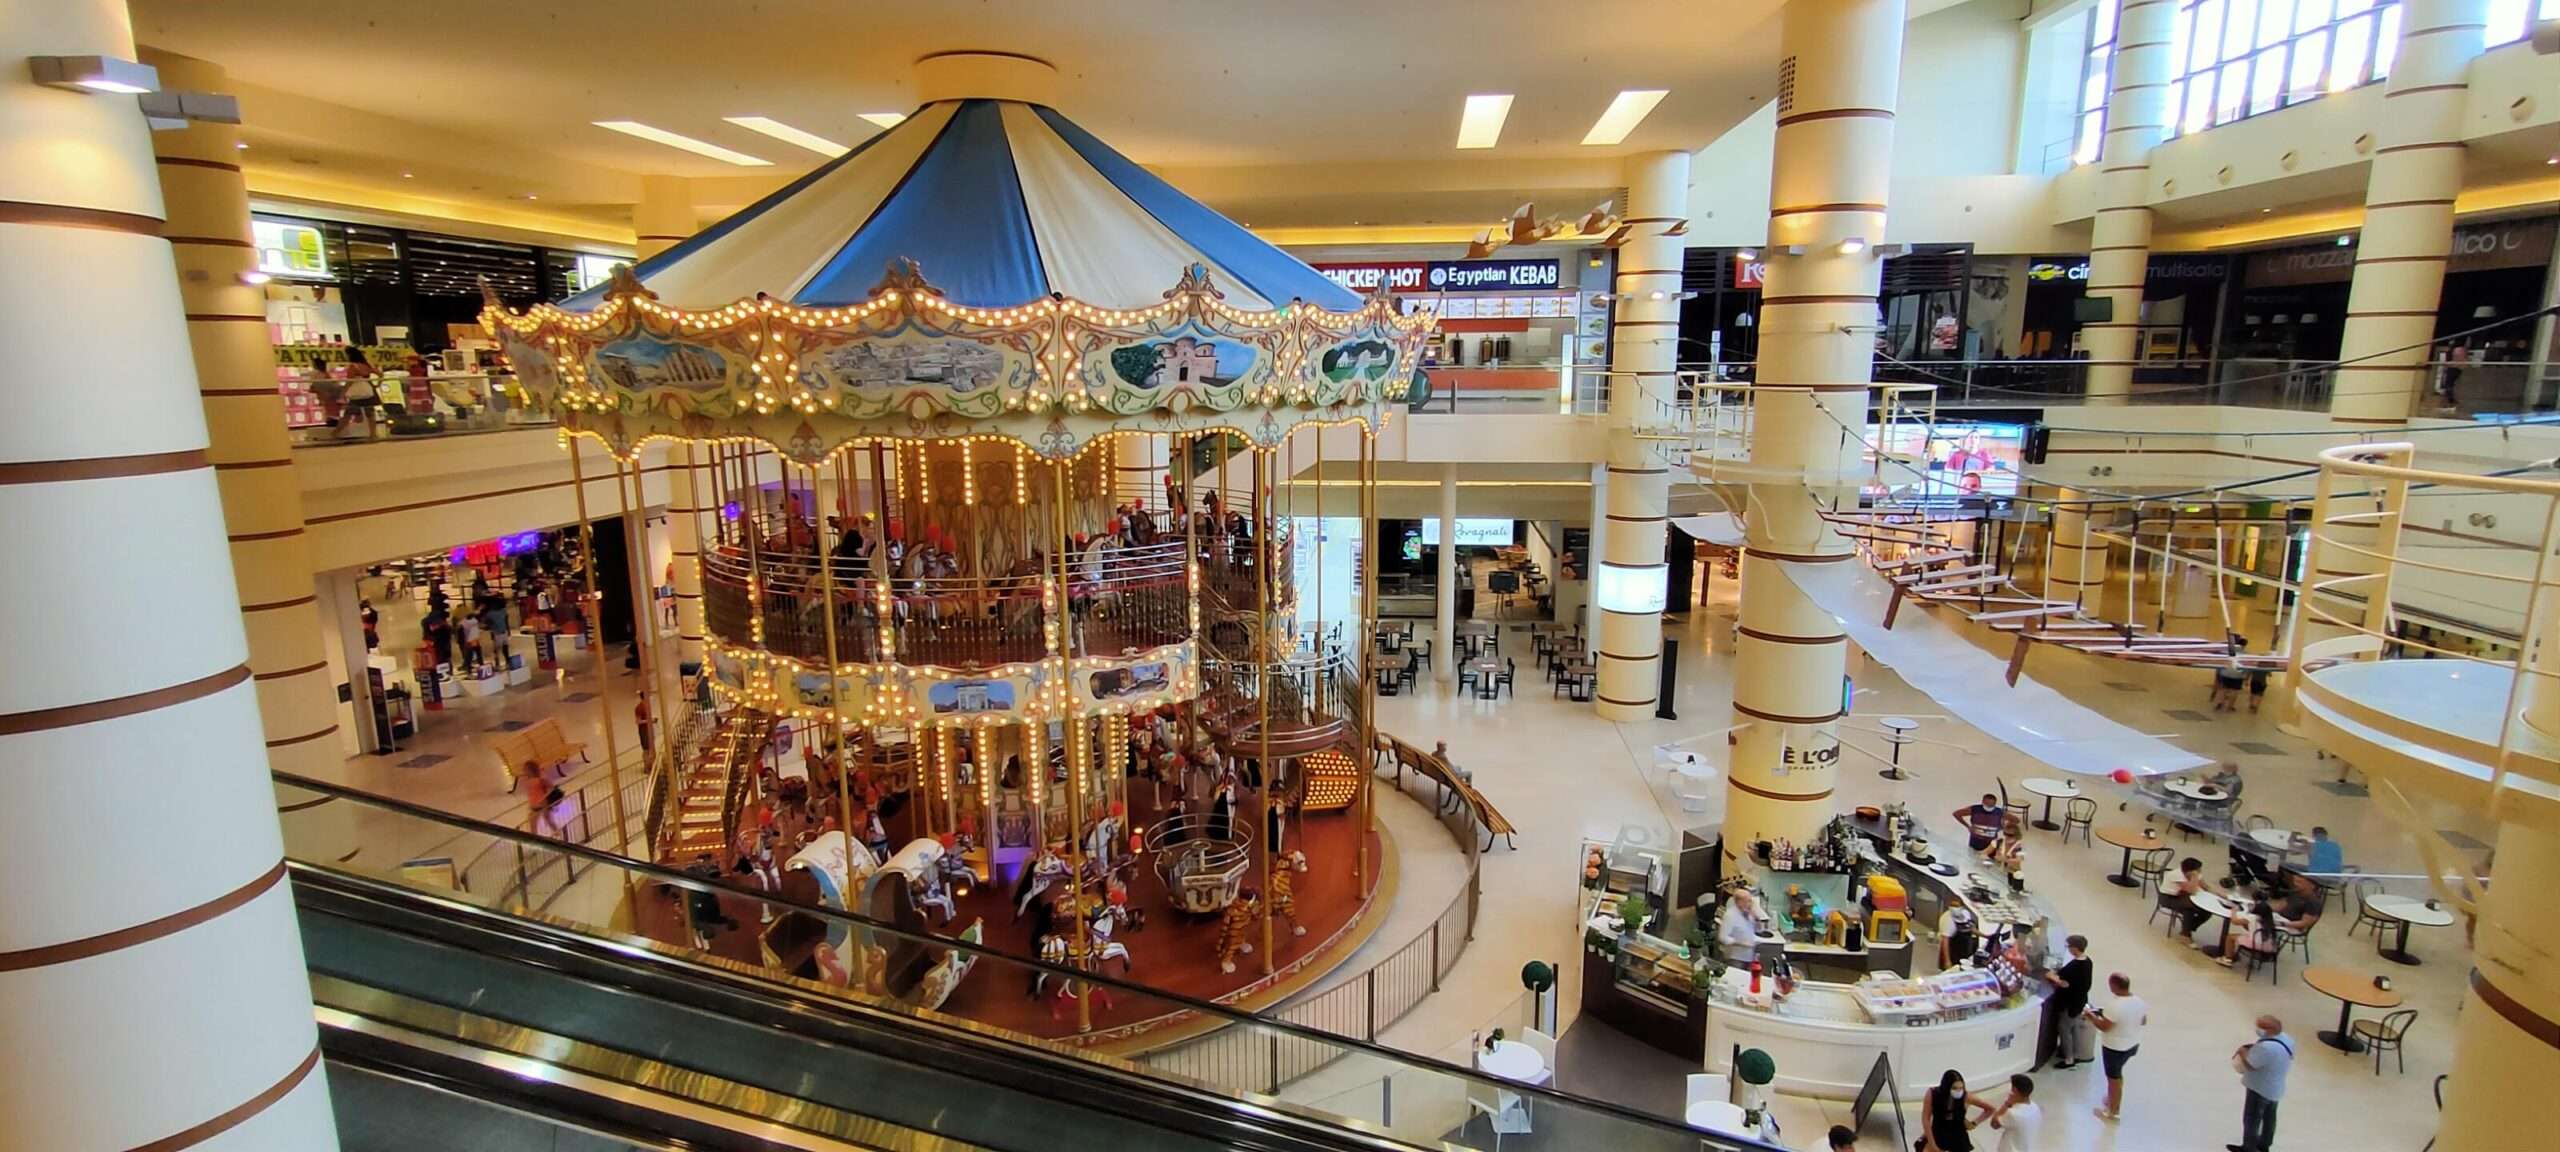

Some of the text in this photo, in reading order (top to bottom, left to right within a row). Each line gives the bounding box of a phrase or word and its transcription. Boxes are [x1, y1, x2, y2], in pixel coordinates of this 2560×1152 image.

[1389, 267, 1423, 288] HOT
[1448, 265, 1557, 286] Egyptian KEBAB
